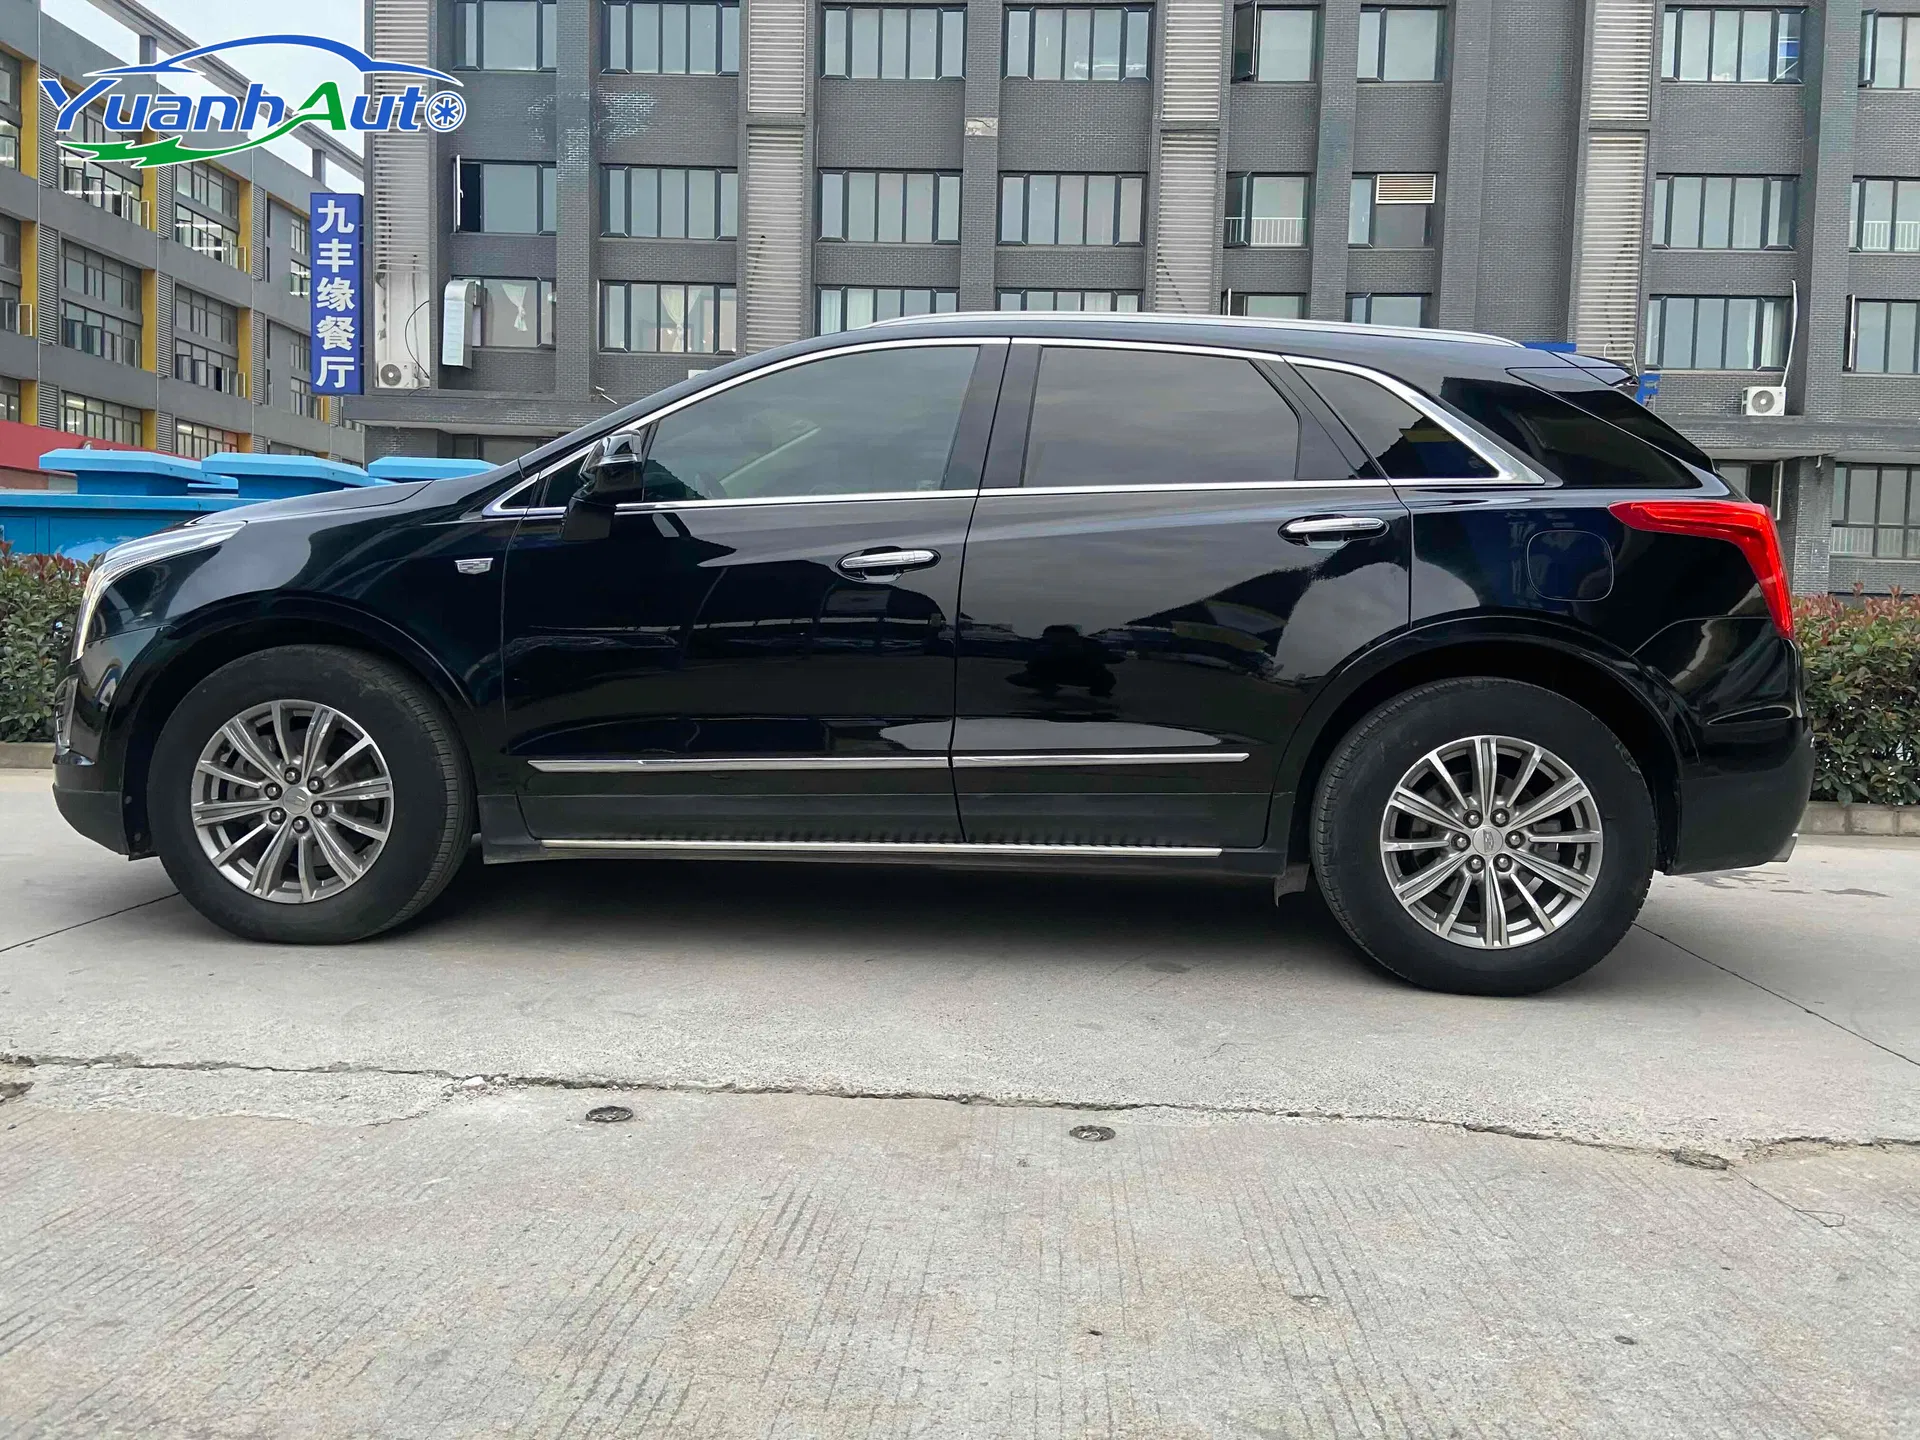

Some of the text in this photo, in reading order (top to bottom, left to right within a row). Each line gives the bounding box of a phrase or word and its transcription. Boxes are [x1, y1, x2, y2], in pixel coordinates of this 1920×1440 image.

[316, 199, 356, 389] 九丰缘餐厅
